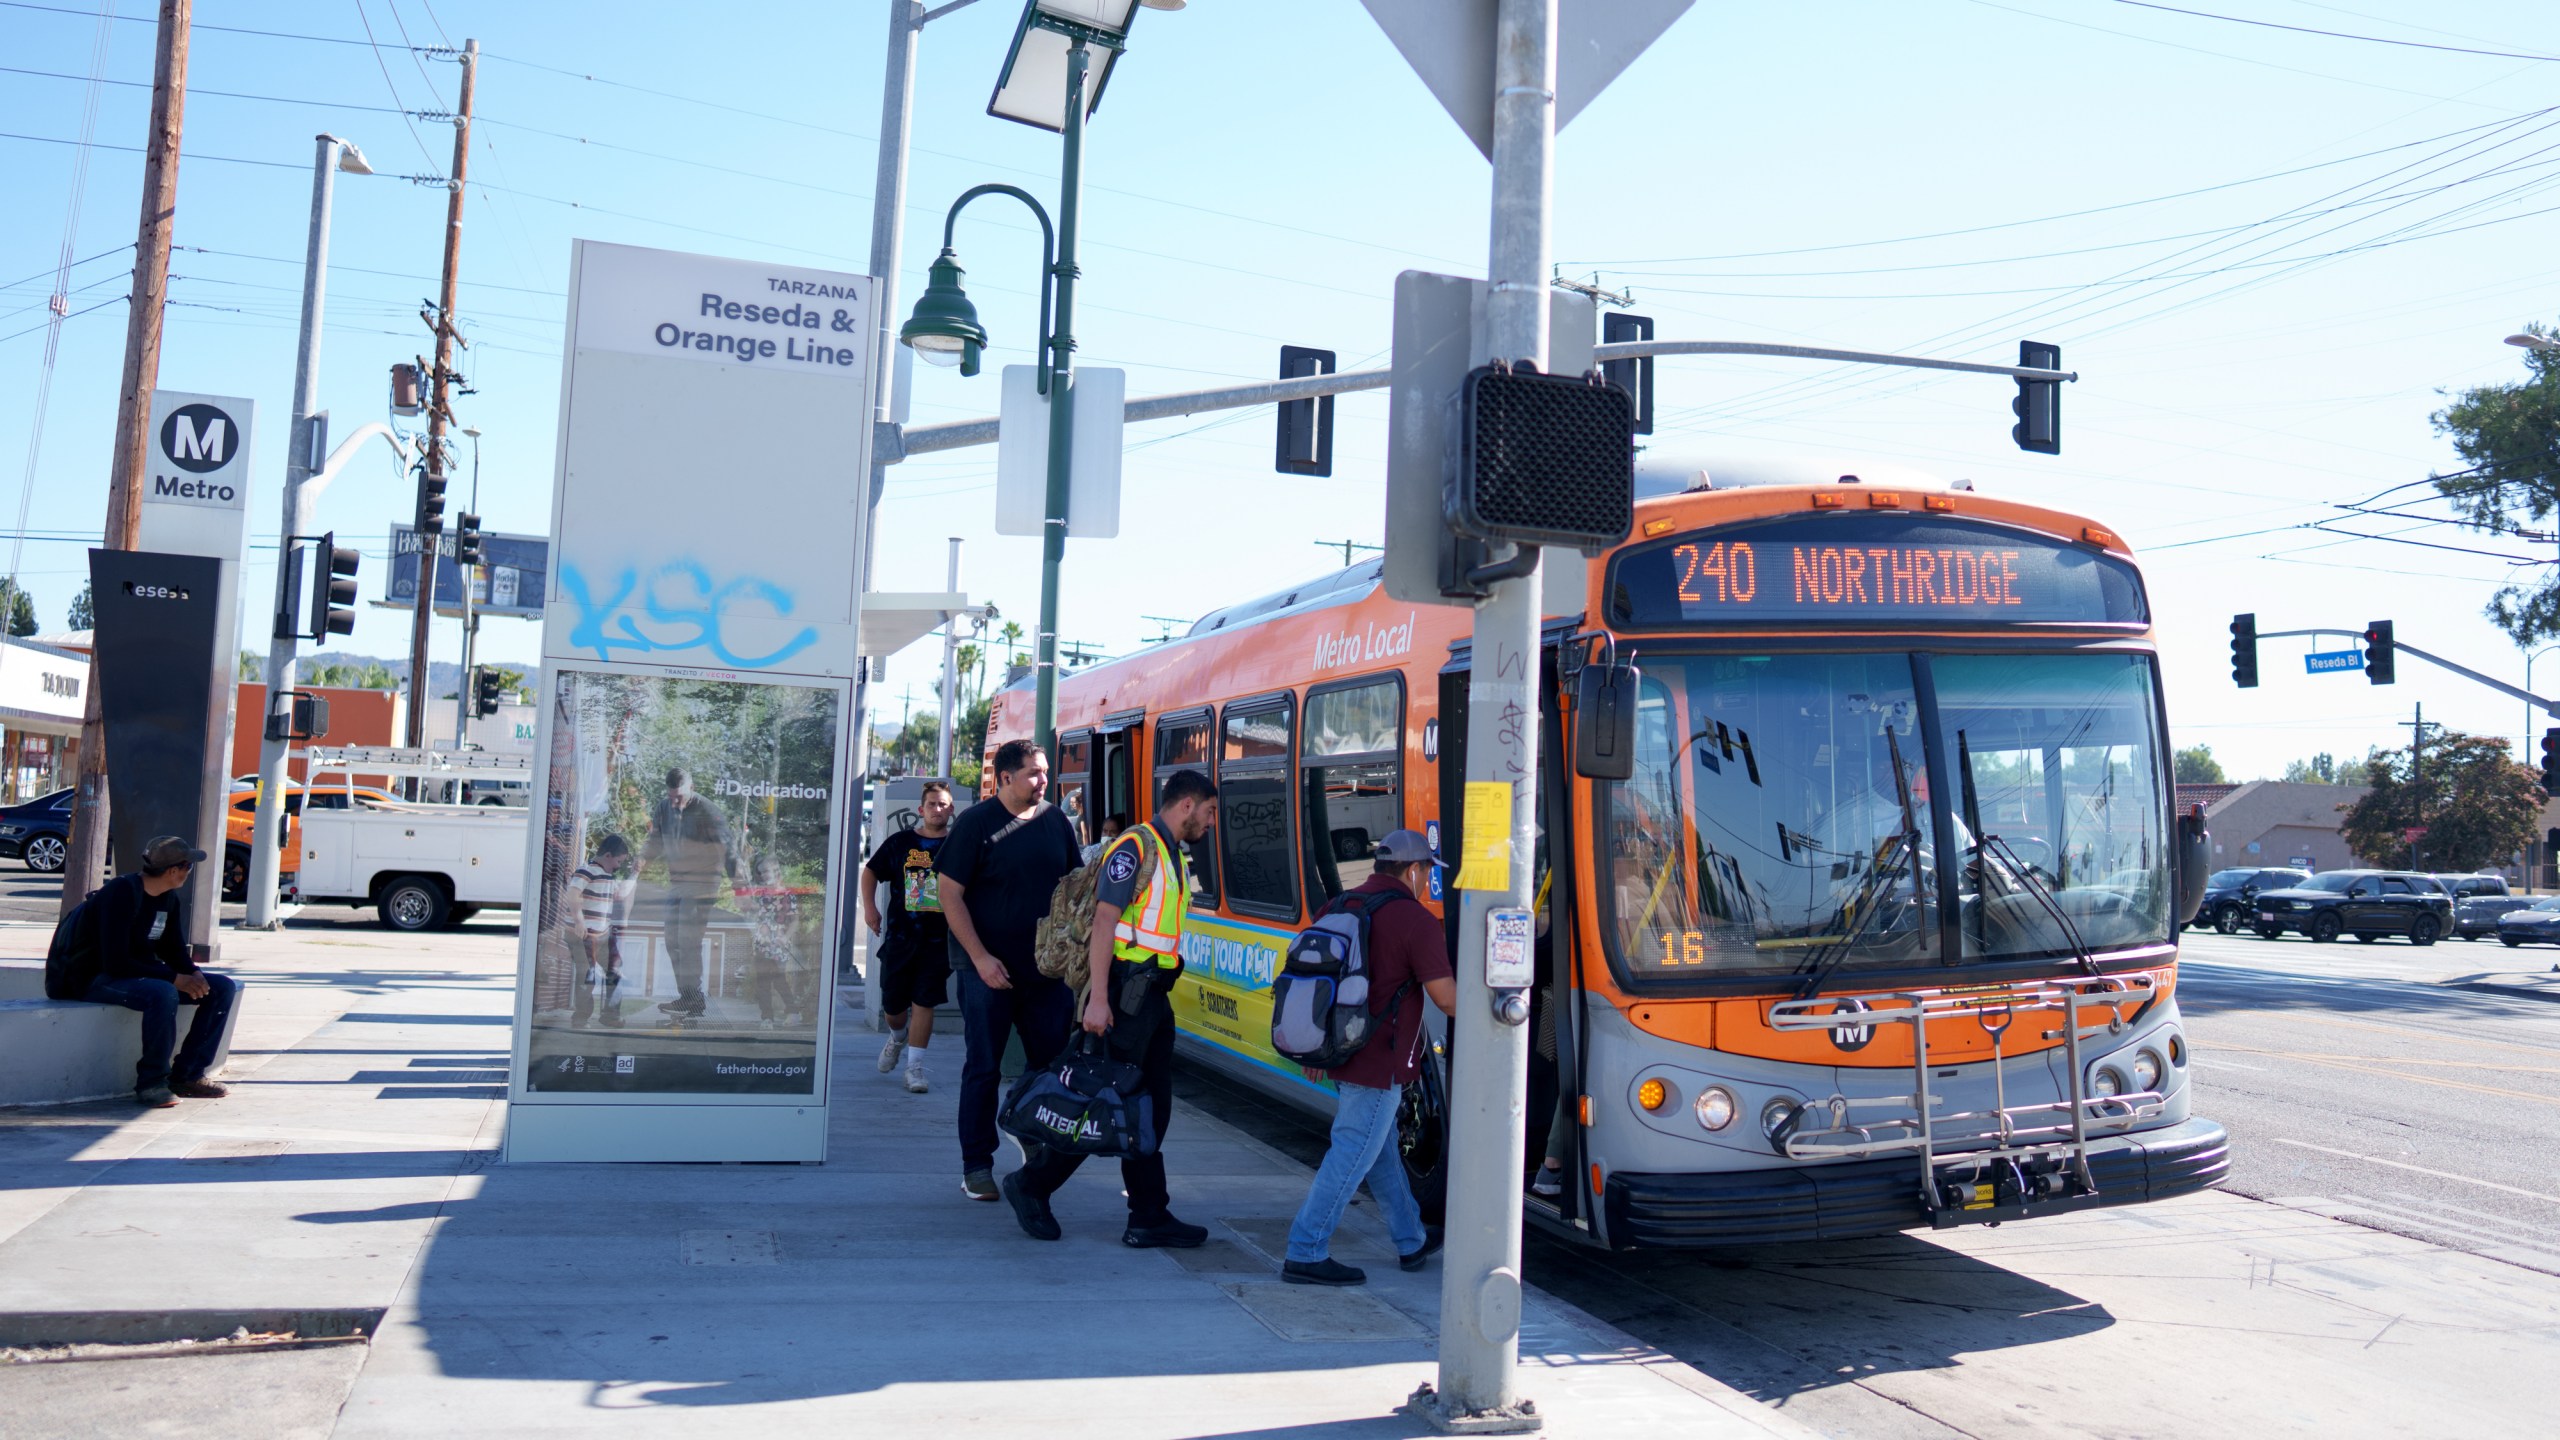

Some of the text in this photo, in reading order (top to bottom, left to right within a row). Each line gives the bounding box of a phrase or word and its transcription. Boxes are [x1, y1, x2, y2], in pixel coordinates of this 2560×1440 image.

[767, 278, 858, 301] TARZANA
[700, 293, 856, 333] Reseda &
[655, 322, 855, 366] Orange Line
[173, 414, 226, 462] M
[155, 475, 235, 502] Metro
[1674, 542, 2022, 604] 240 NORTHRIDGE
[1312, 610, 1416, 671] Metro Local
[664, 668, 698, 677] TRANZITO
[2310, 654, 2359, 670] Reseda Bl
[1425, 725, 1439, 755] M
[714, 780, 827, 800] #Dadication
[1191, 933, 1212, 966] OFF
[1214, 936, 1243, 975] YOUR
[1245, 943, 1279, 984] PLAY
[1661, 931, 1704, 965] 16
[1206, 991, 1239, 1021] SCRATCHERS
[618, 1057, 633, 1068] ad
[716, 1063, 808, 1077] fatherhood.gov
